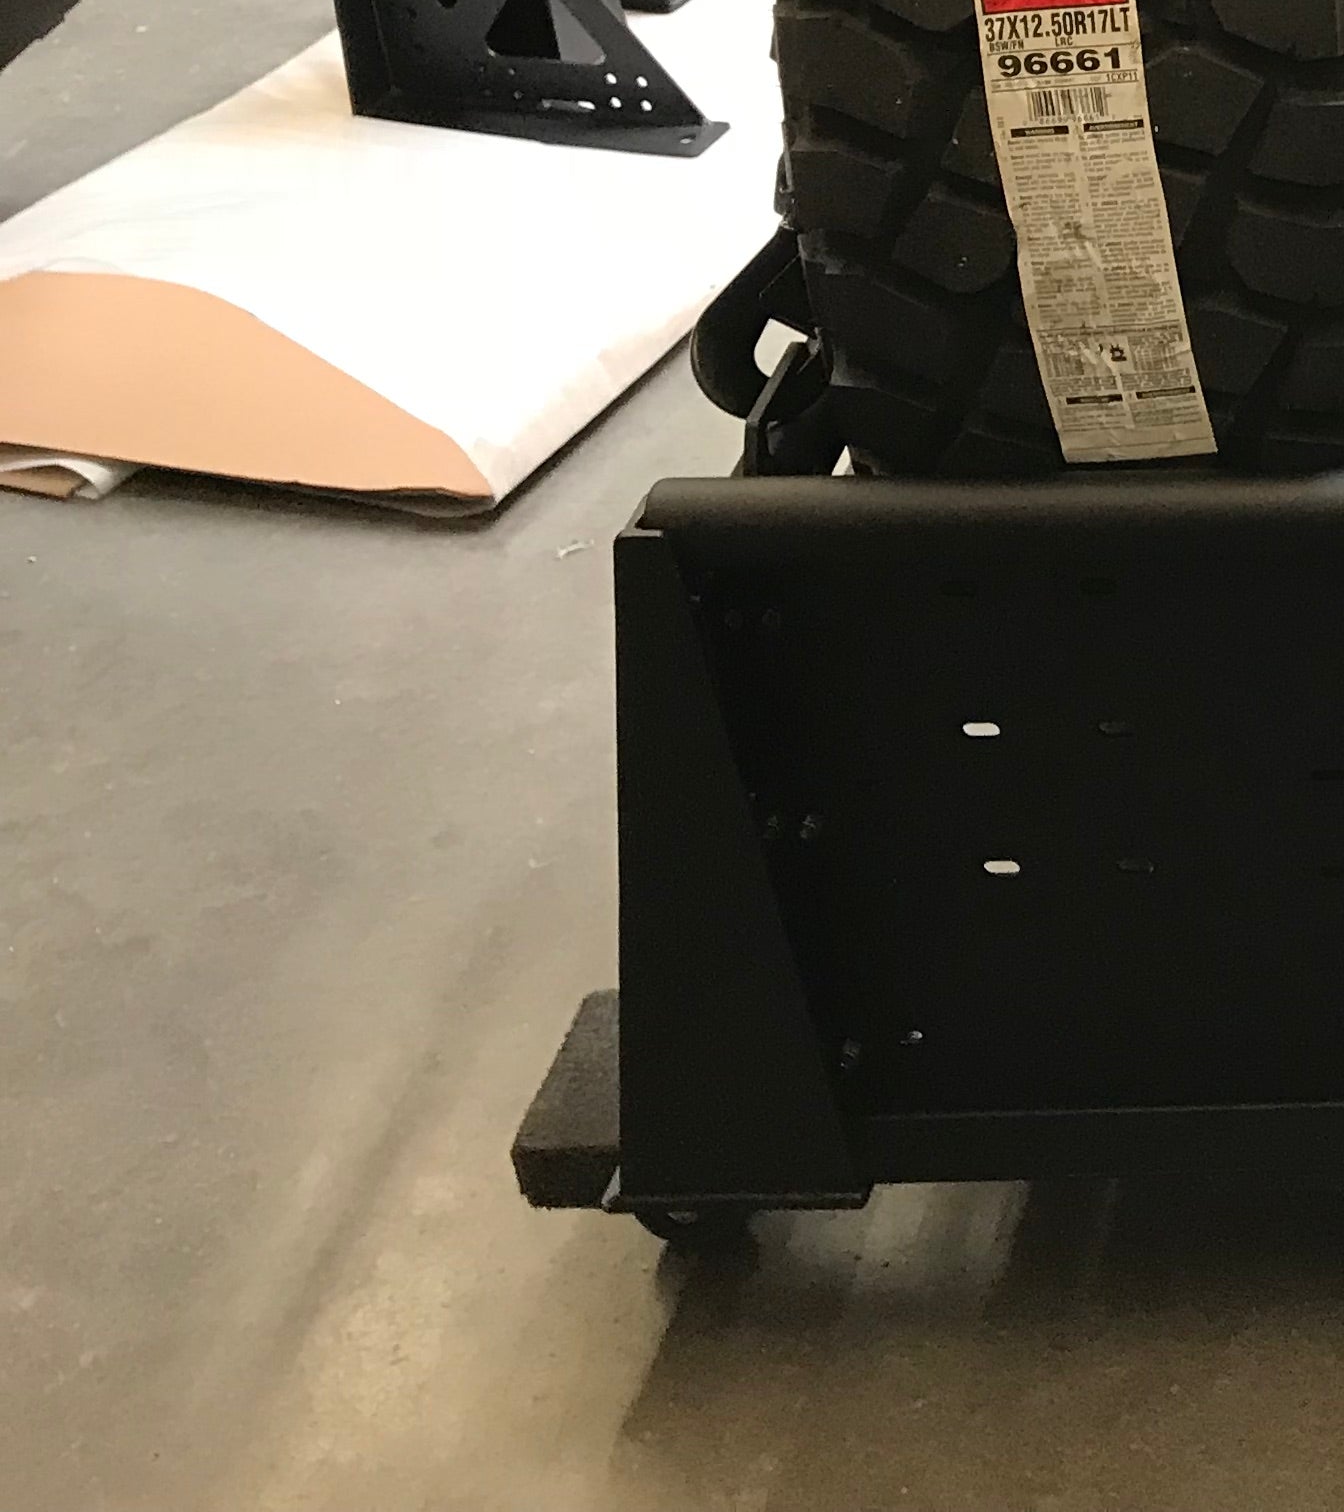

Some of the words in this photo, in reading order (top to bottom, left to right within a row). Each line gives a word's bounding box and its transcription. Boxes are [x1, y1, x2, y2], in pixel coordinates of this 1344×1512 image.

[984, 7, 1130, 42] 37X12.50R17LT
[1055, 36, 1073, 47] LRC
[998, 48, 1120, 77] 96661
